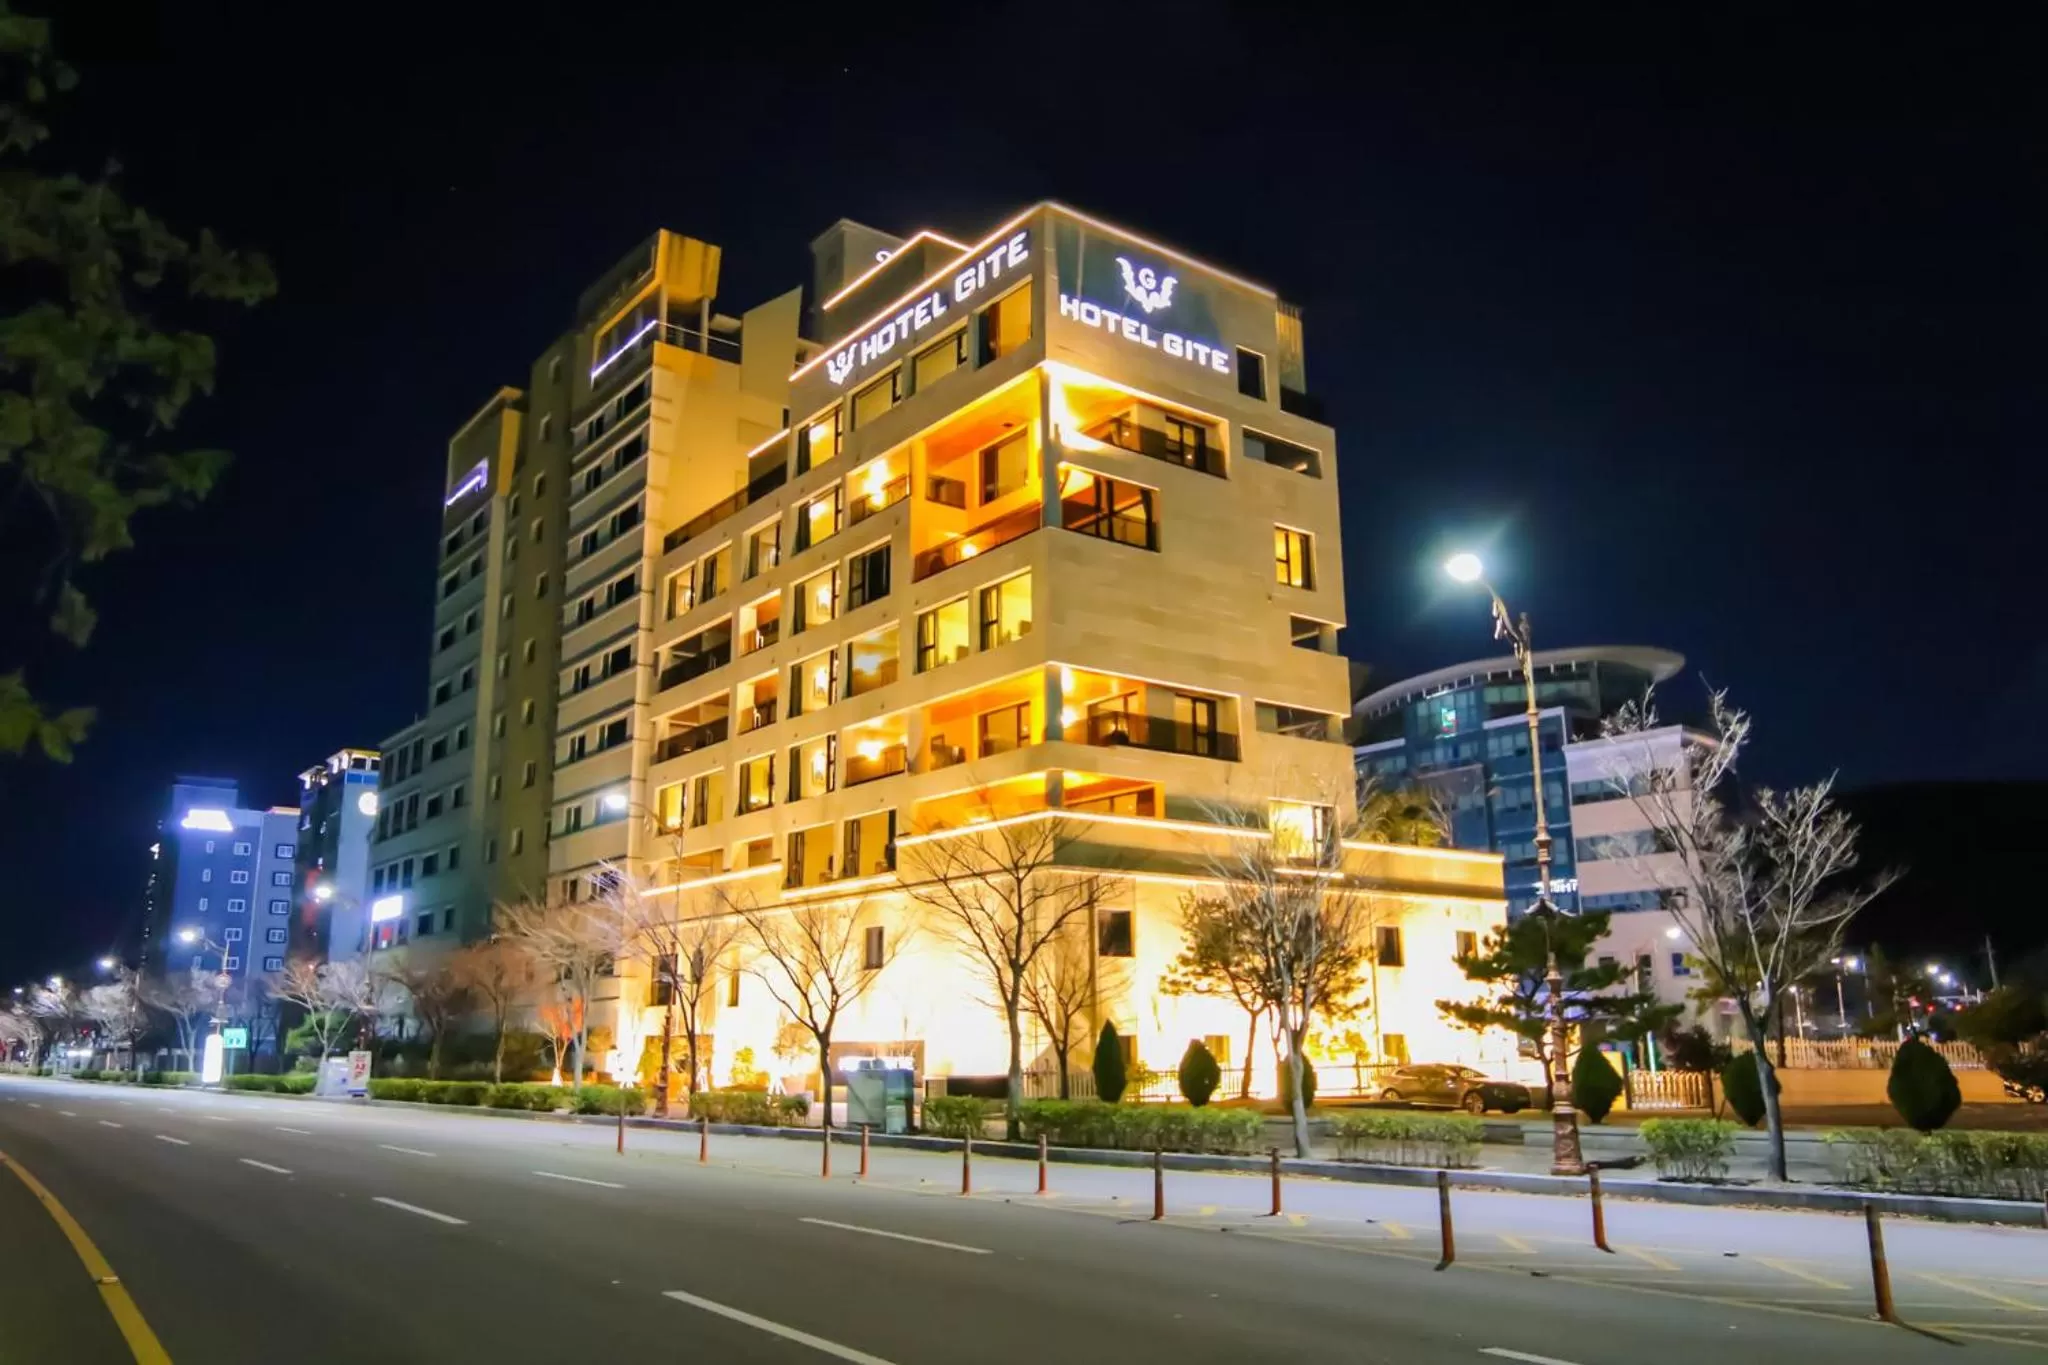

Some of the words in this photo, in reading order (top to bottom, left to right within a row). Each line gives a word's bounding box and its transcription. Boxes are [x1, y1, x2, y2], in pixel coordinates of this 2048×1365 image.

[861, 291, 947, 366] HOTEL
[955, 231, 1029, 302] GITE
[1138, 267, 1157, 290] G
[1060, 294, 1157, 348] HOTEL
[1163, 333, 1230, 374] GITE
